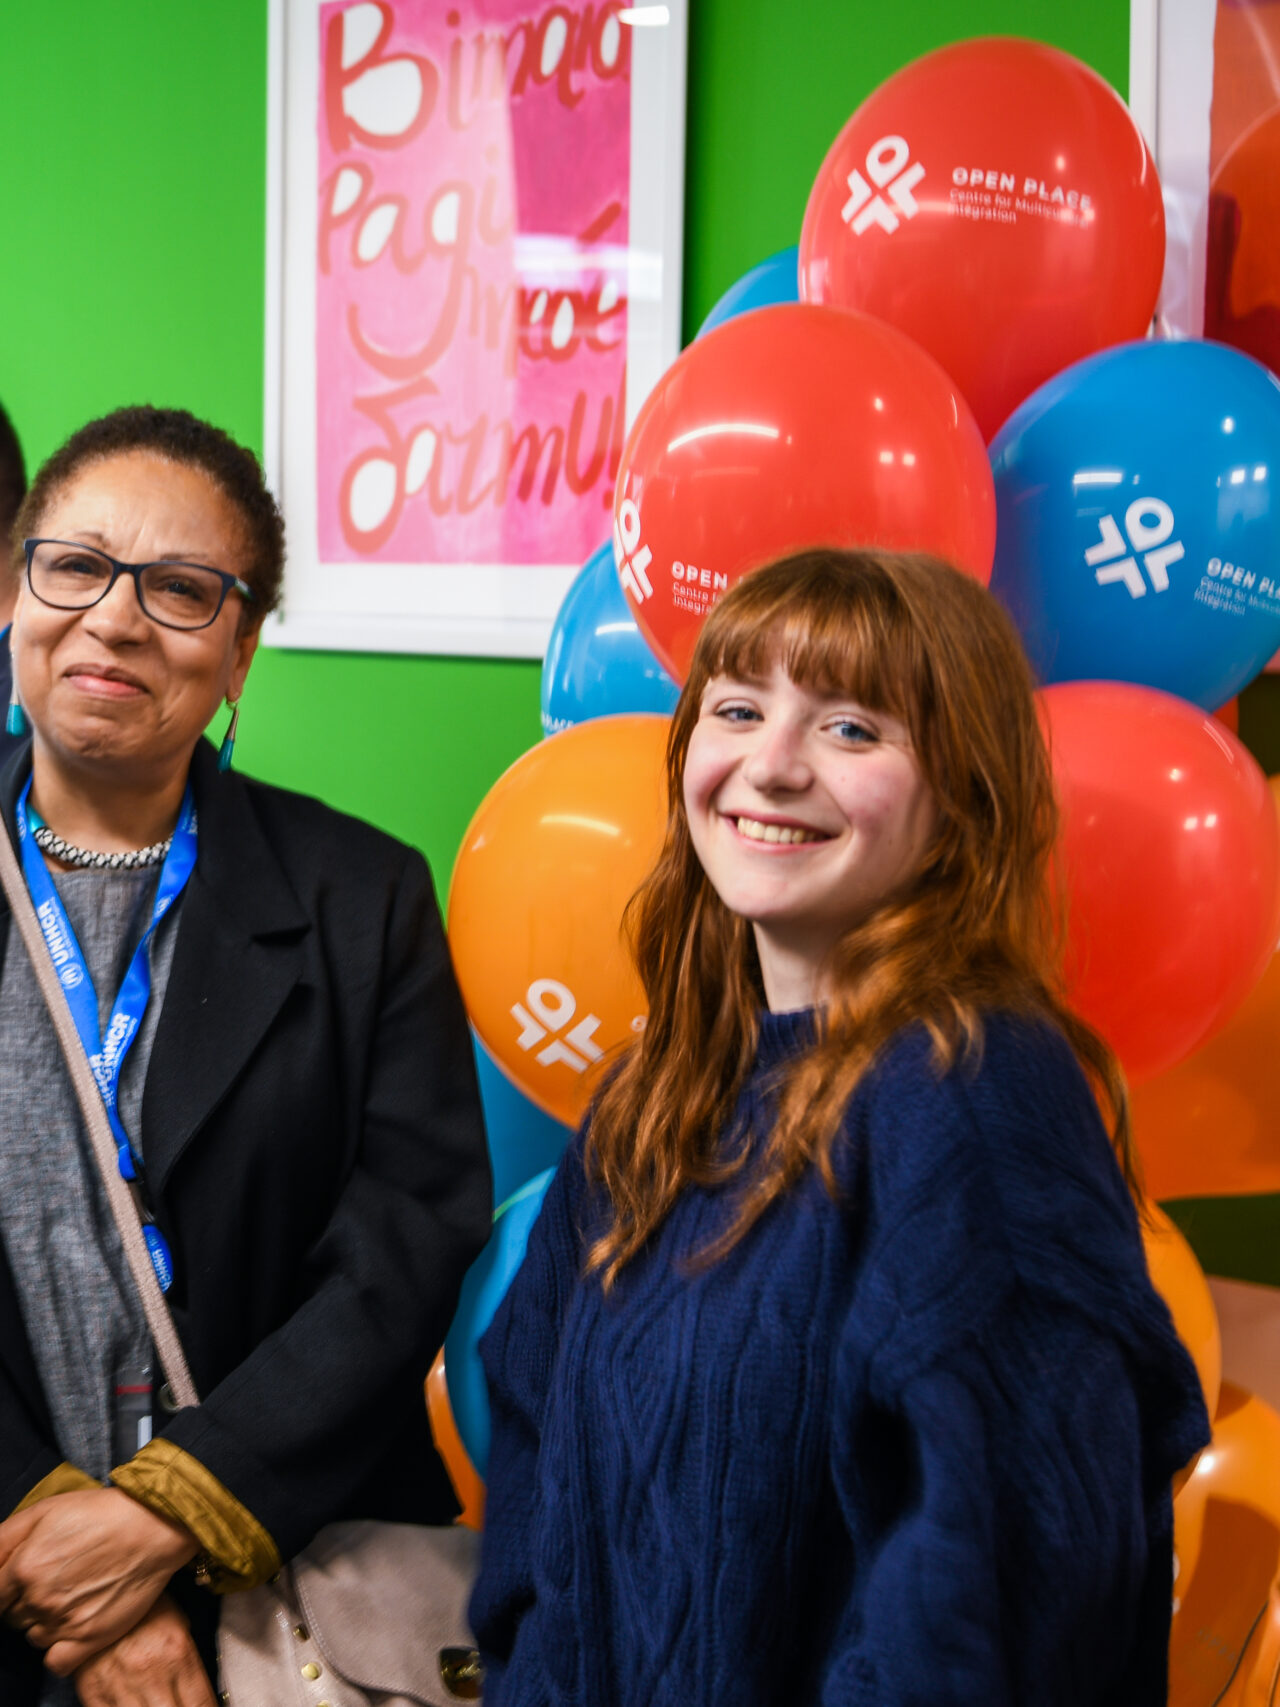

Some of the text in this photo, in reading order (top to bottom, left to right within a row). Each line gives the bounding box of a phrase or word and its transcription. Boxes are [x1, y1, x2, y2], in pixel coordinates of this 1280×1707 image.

[949, 188, 992, 206] Centre
[995, 193, 1012, 208] for
[952, 167, 1091, 210] OPEN PLACE
[672, 560, 728, 590] OPEN
[1207, 557, 1256, 590] OPEN
[673, 581, 709, 604] Centre
[673, 594, 712, 616] Integra
[37, 900, 69, 967] UNHCR
[104, 1012, 131, 1081] UNHCR
